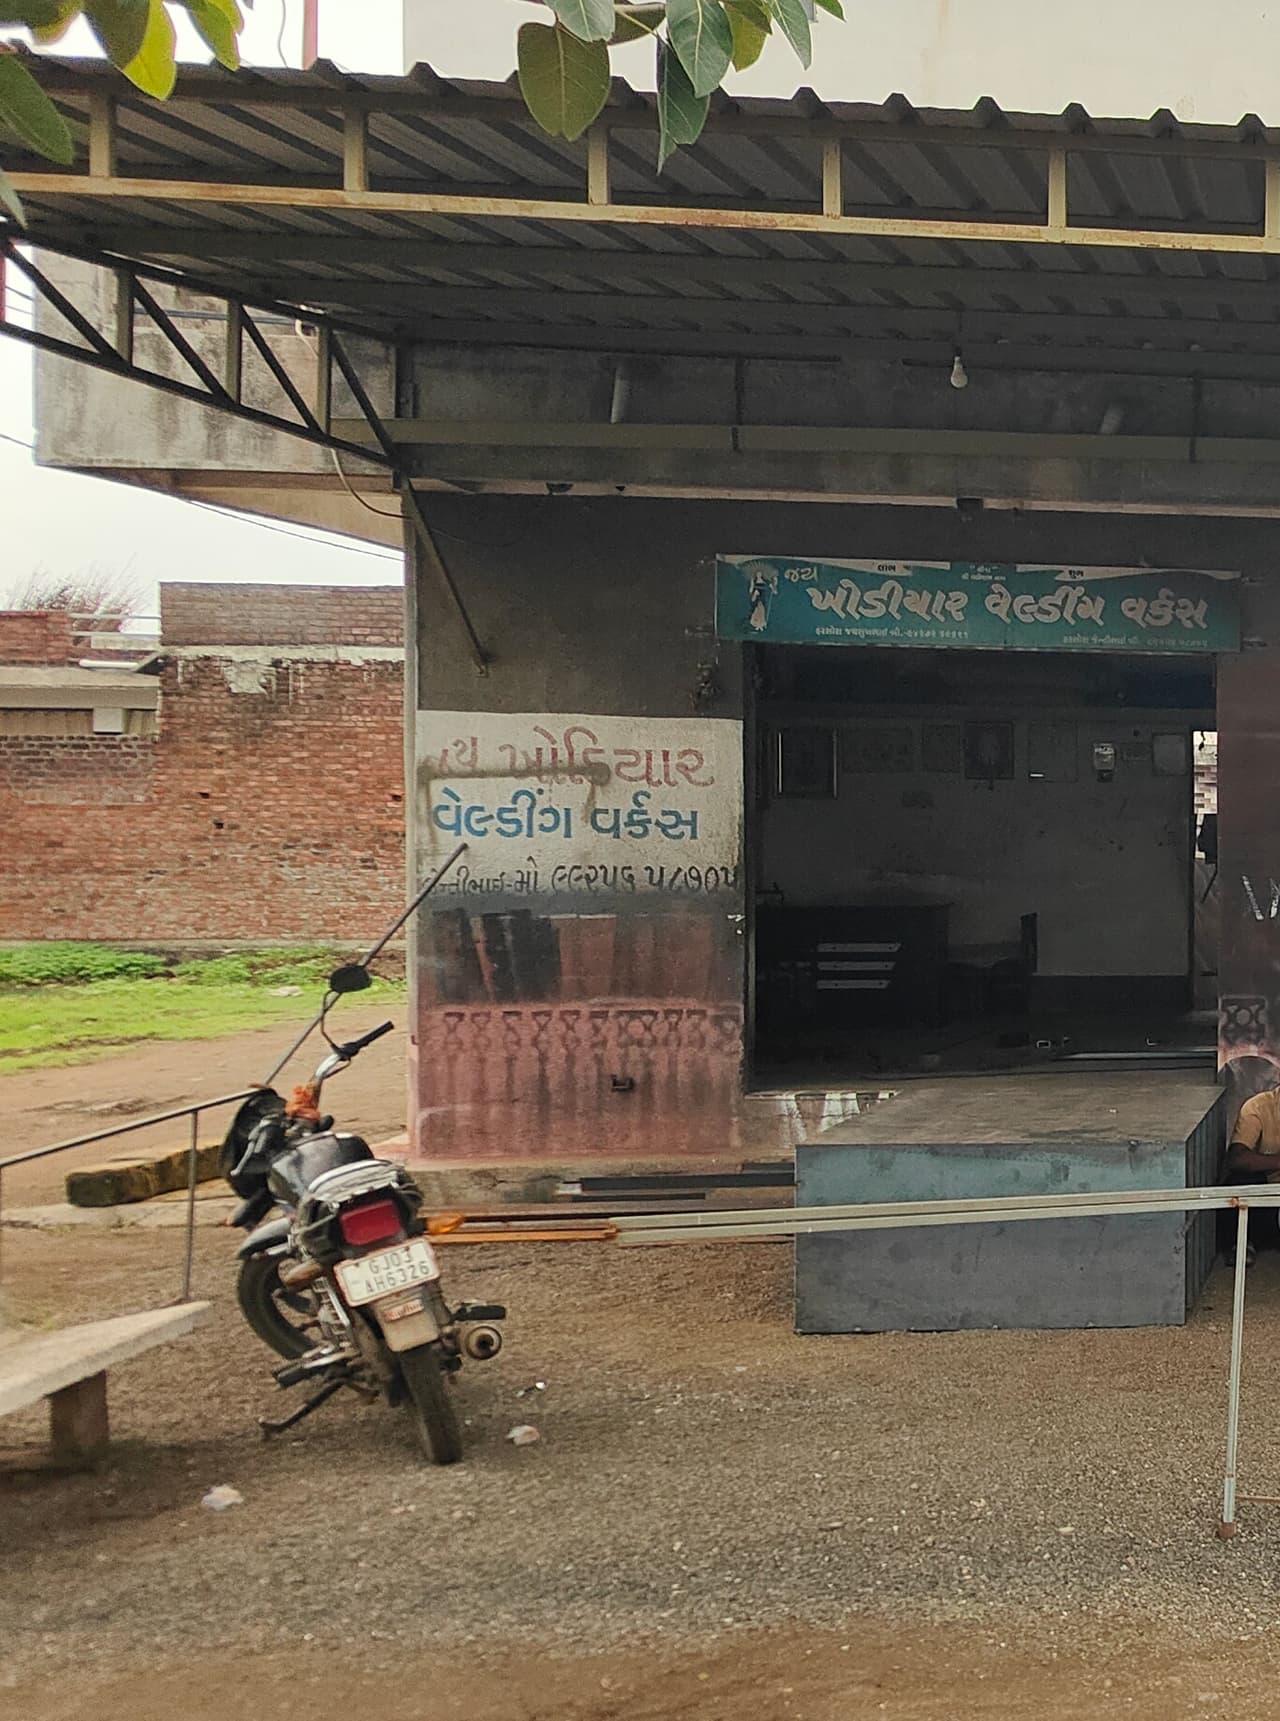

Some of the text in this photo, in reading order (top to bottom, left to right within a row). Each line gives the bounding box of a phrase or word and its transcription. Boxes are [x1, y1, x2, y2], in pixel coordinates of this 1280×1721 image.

[805, 577, 969, 623] ખોડીયાર
[1121, 587, 1208, 630] વર્કસ
[432, 785, 699, 841] વેલ્ડીંગ વર્કસ
